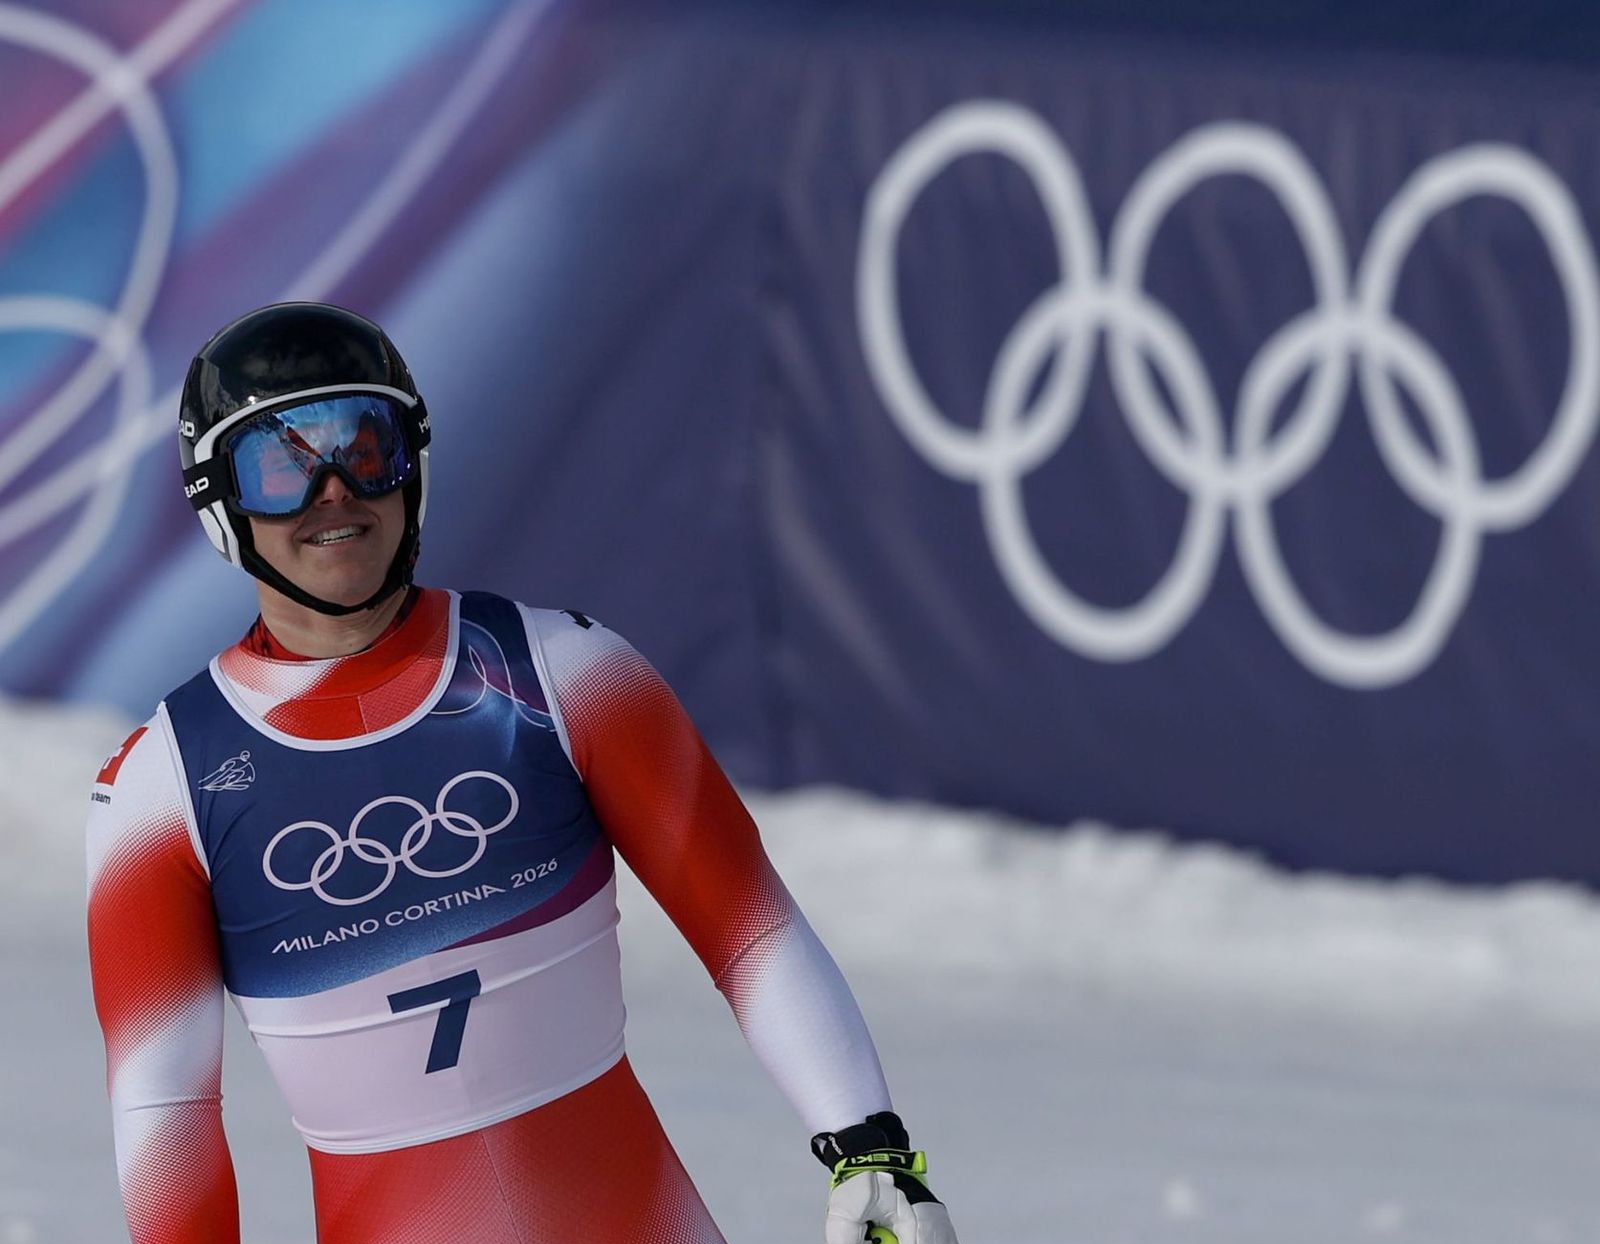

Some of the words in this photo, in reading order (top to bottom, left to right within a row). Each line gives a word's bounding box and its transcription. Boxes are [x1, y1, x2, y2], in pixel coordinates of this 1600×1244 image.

[184, 476, 210, 498] EAD
[272, 918, 380, 954] MILANO
[384, 883, 506, 926] CORTINA
[510, 857, 559, 889] 2026
[386, 968, 482, 1075] 7
[850, 1152, 906, 1165] LEKI
